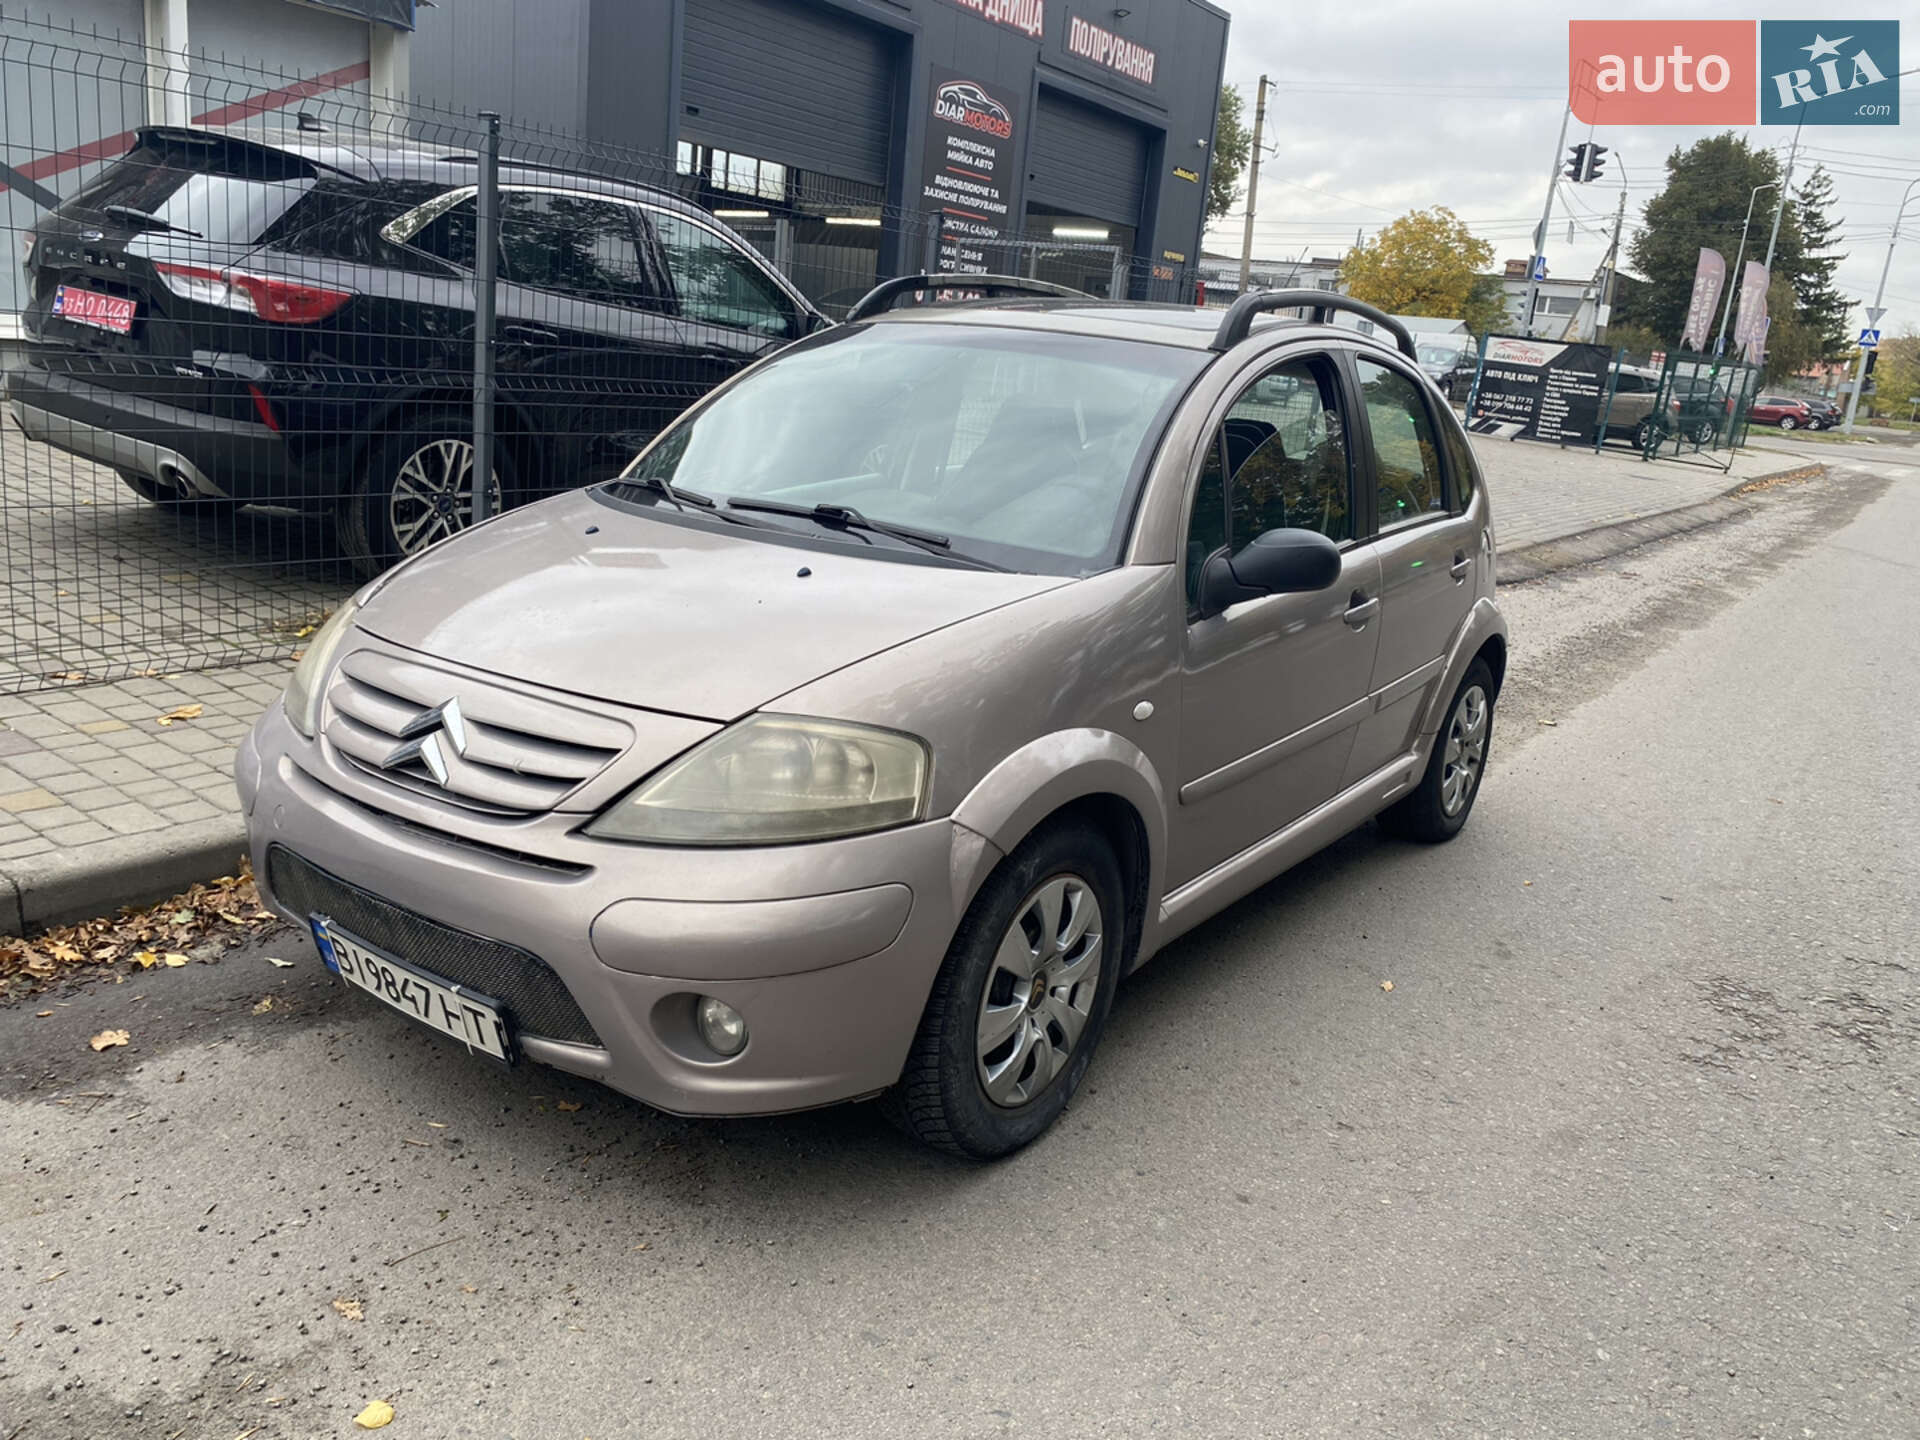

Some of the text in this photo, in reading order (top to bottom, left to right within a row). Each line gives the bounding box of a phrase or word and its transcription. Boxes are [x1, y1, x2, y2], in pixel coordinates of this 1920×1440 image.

[1069, 15, 1155, 84] ПОЛІРУВАННЯ
[935, 99, 1011, 136] DIARMOTORS
[974, 157, 994, 170] АВТО
